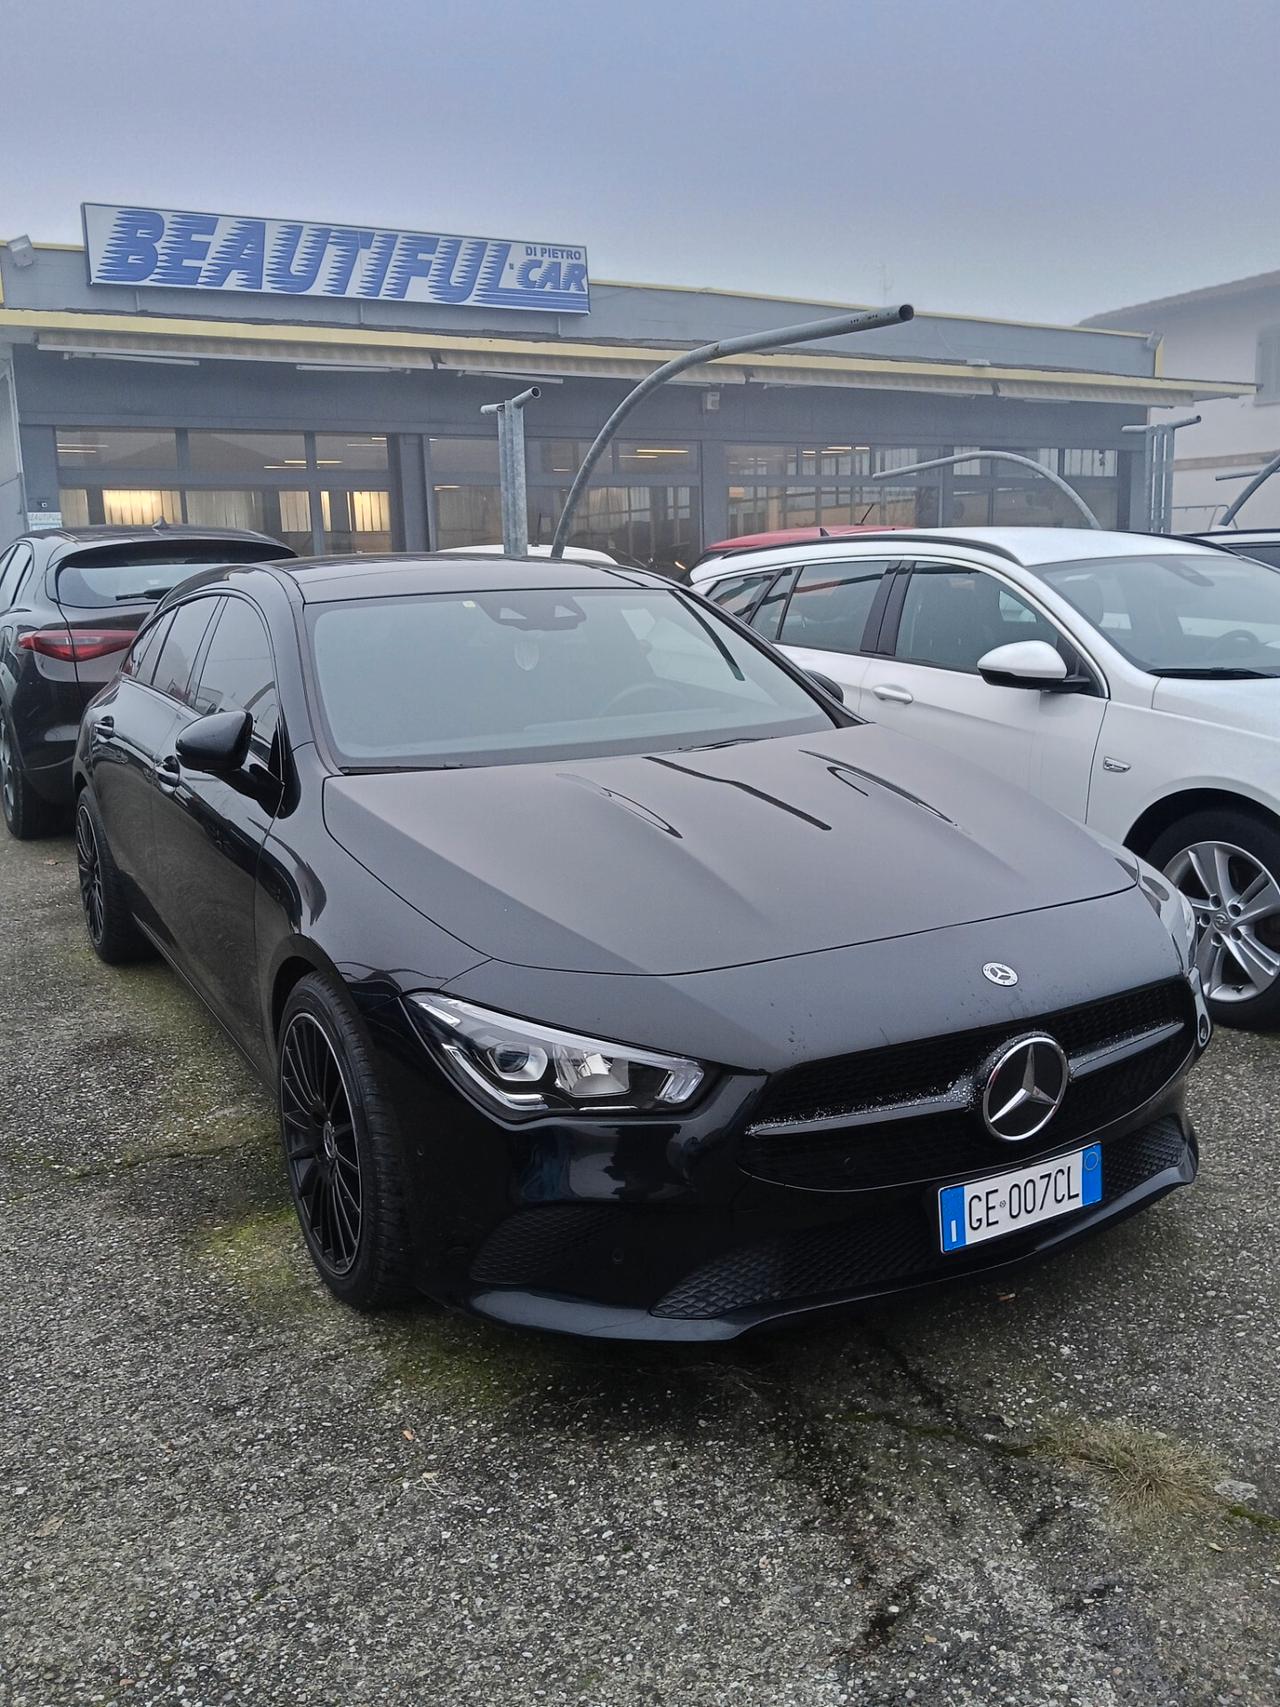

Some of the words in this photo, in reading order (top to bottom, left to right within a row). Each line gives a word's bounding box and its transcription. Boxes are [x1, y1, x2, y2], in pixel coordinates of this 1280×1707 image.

[95, 210, 511, 304] BEAUTIFUL
[516, 259, 586, 292] CAR
[525, 246, 537, 257] DI
[540, 247, 582, 260] PIETRO
[968, 1188, 999, 1231] GE
[1008, 1165, 1080, 1219] 007CL
[950, 1219, 957, 1243] I
